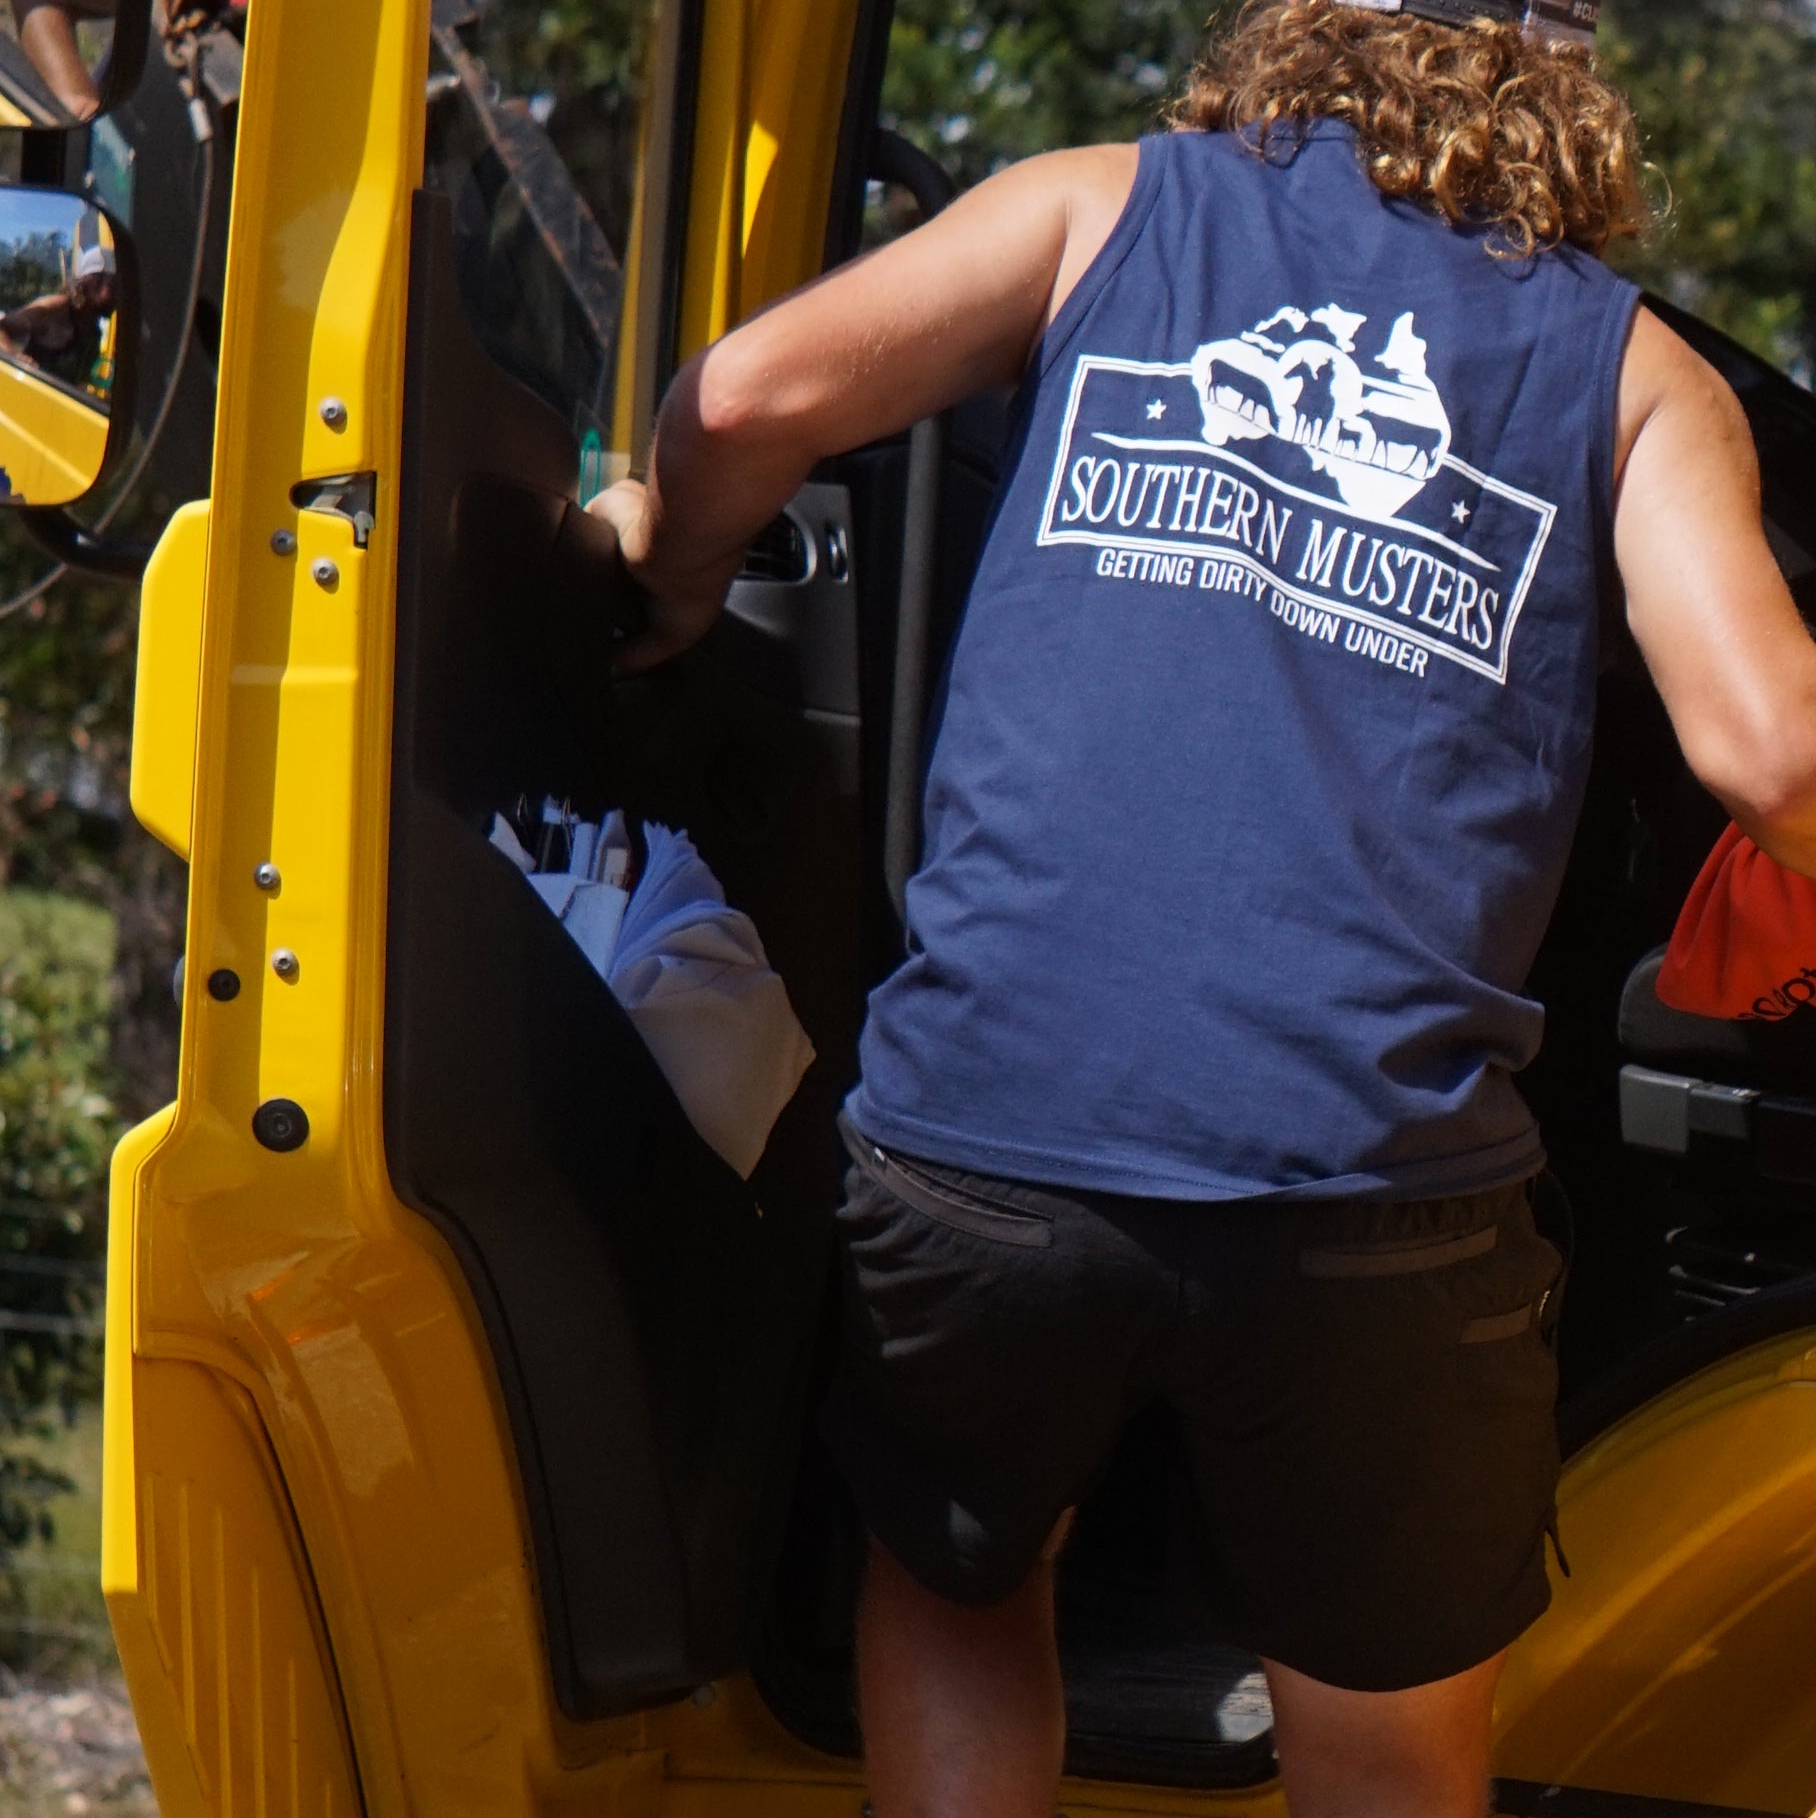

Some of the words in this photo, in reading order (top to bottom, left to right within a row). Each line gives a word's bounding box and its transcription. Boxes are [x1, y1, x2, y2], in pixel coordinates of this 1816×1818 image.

[1061, 453, 1294, 566] SOUTHERN
[1295, 517, 1499, 652] MUSTERS
[1096, 547, 1194, 586] GETTING
[1199, 555, 1270, 602] DIRTY
[1270, 591, 1340, 645] DOWN
[1344, 625, 1430, 678] UNDER
